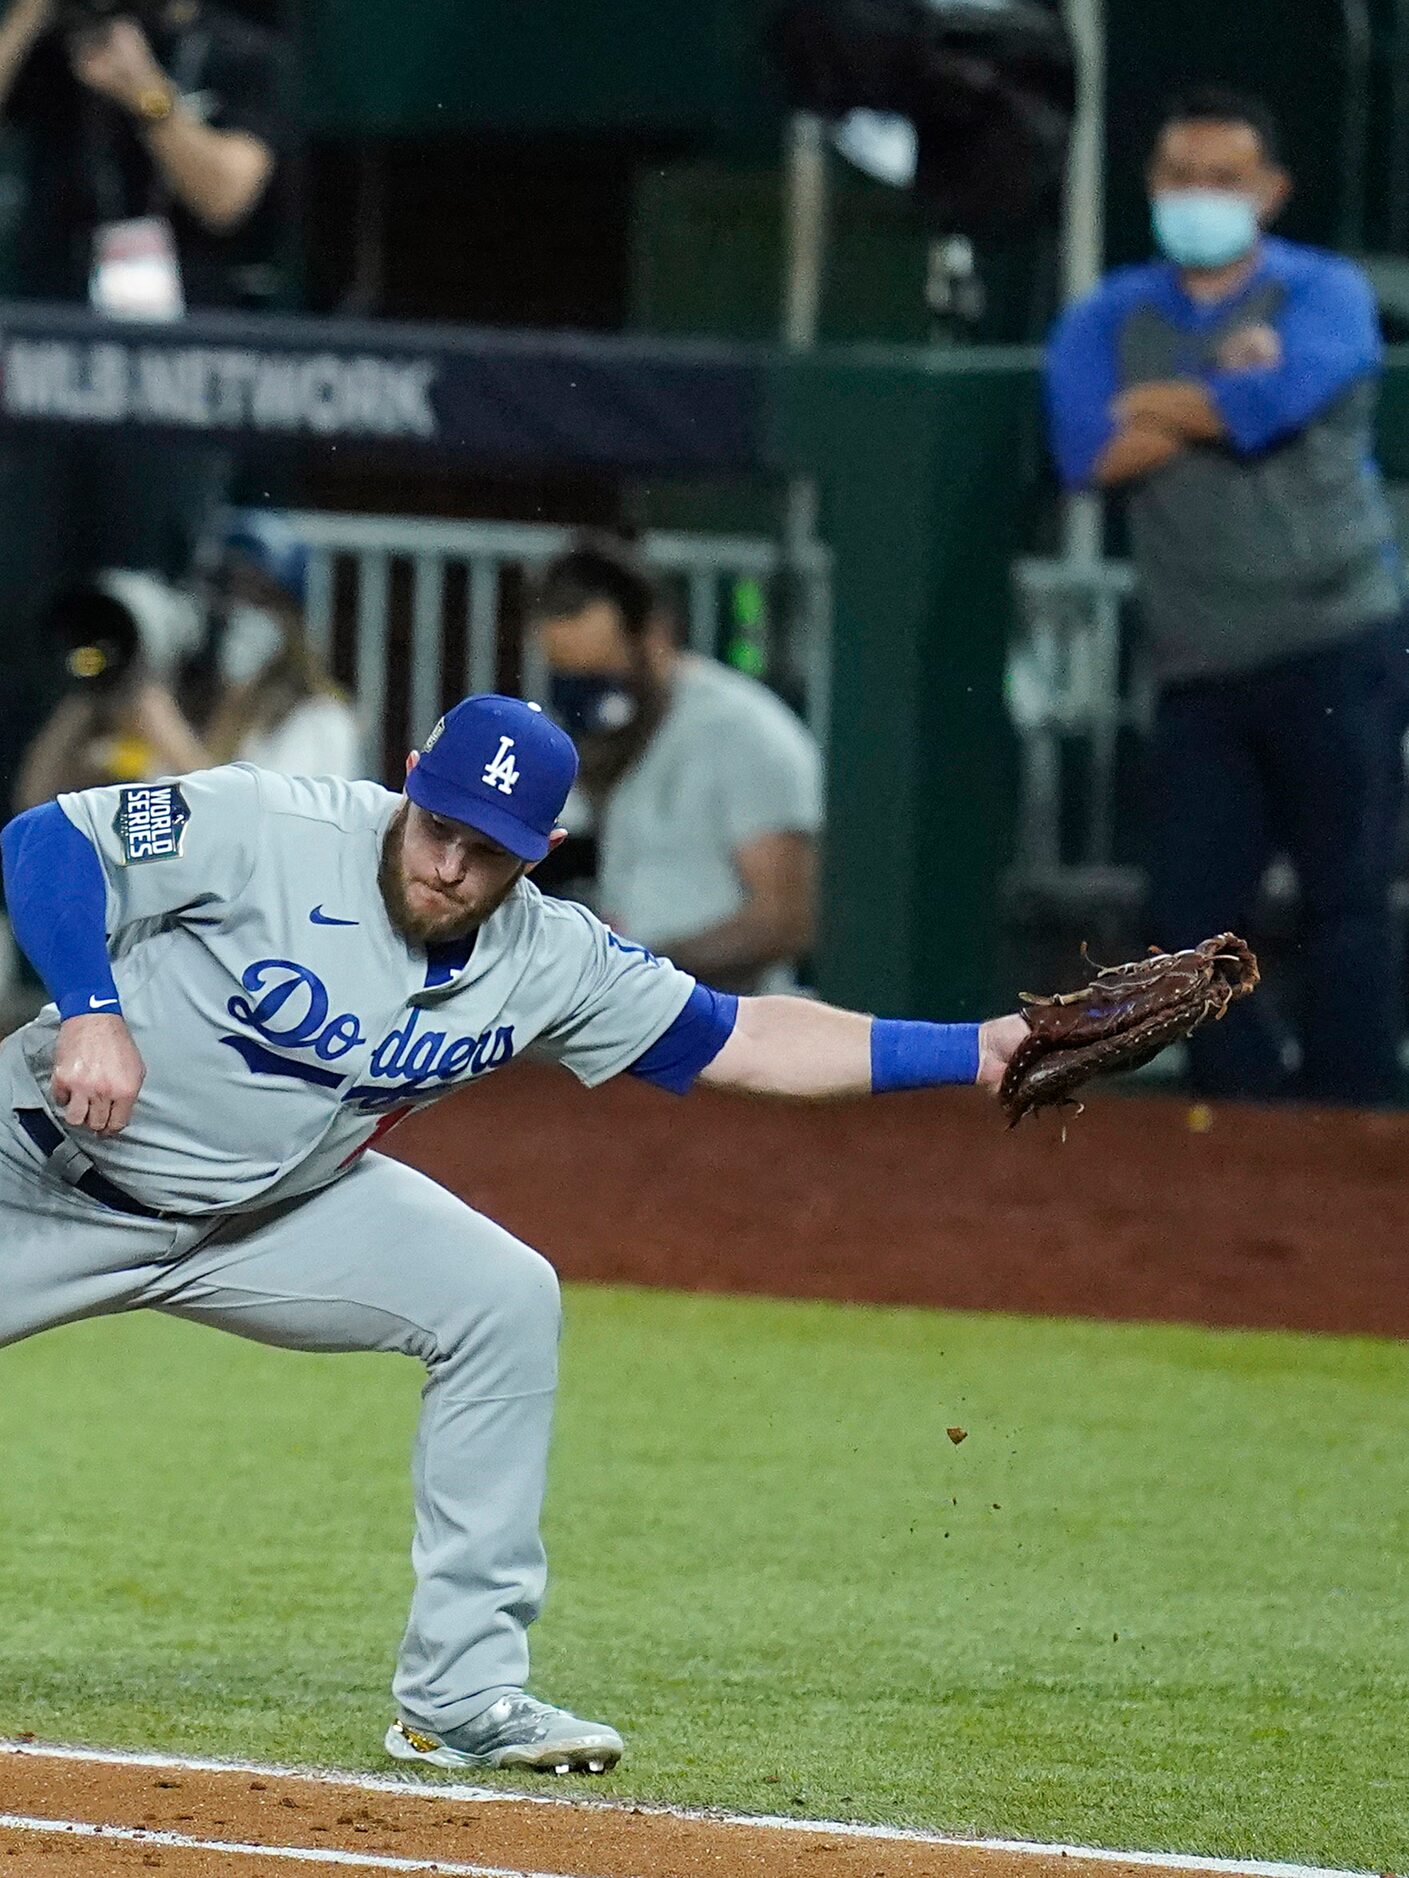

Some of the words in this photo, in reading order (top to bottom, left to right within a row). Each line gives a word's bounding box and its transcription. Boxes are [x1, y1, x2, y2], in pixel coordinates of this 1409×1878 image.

[4, 338, 129, 424] MLB
[137, 348, 436, 437] NETWORK
[481, 735, 520, 795] LA
[127, 790, 153, 858] SERIES
[150, 788, 173, 854] WORLD
